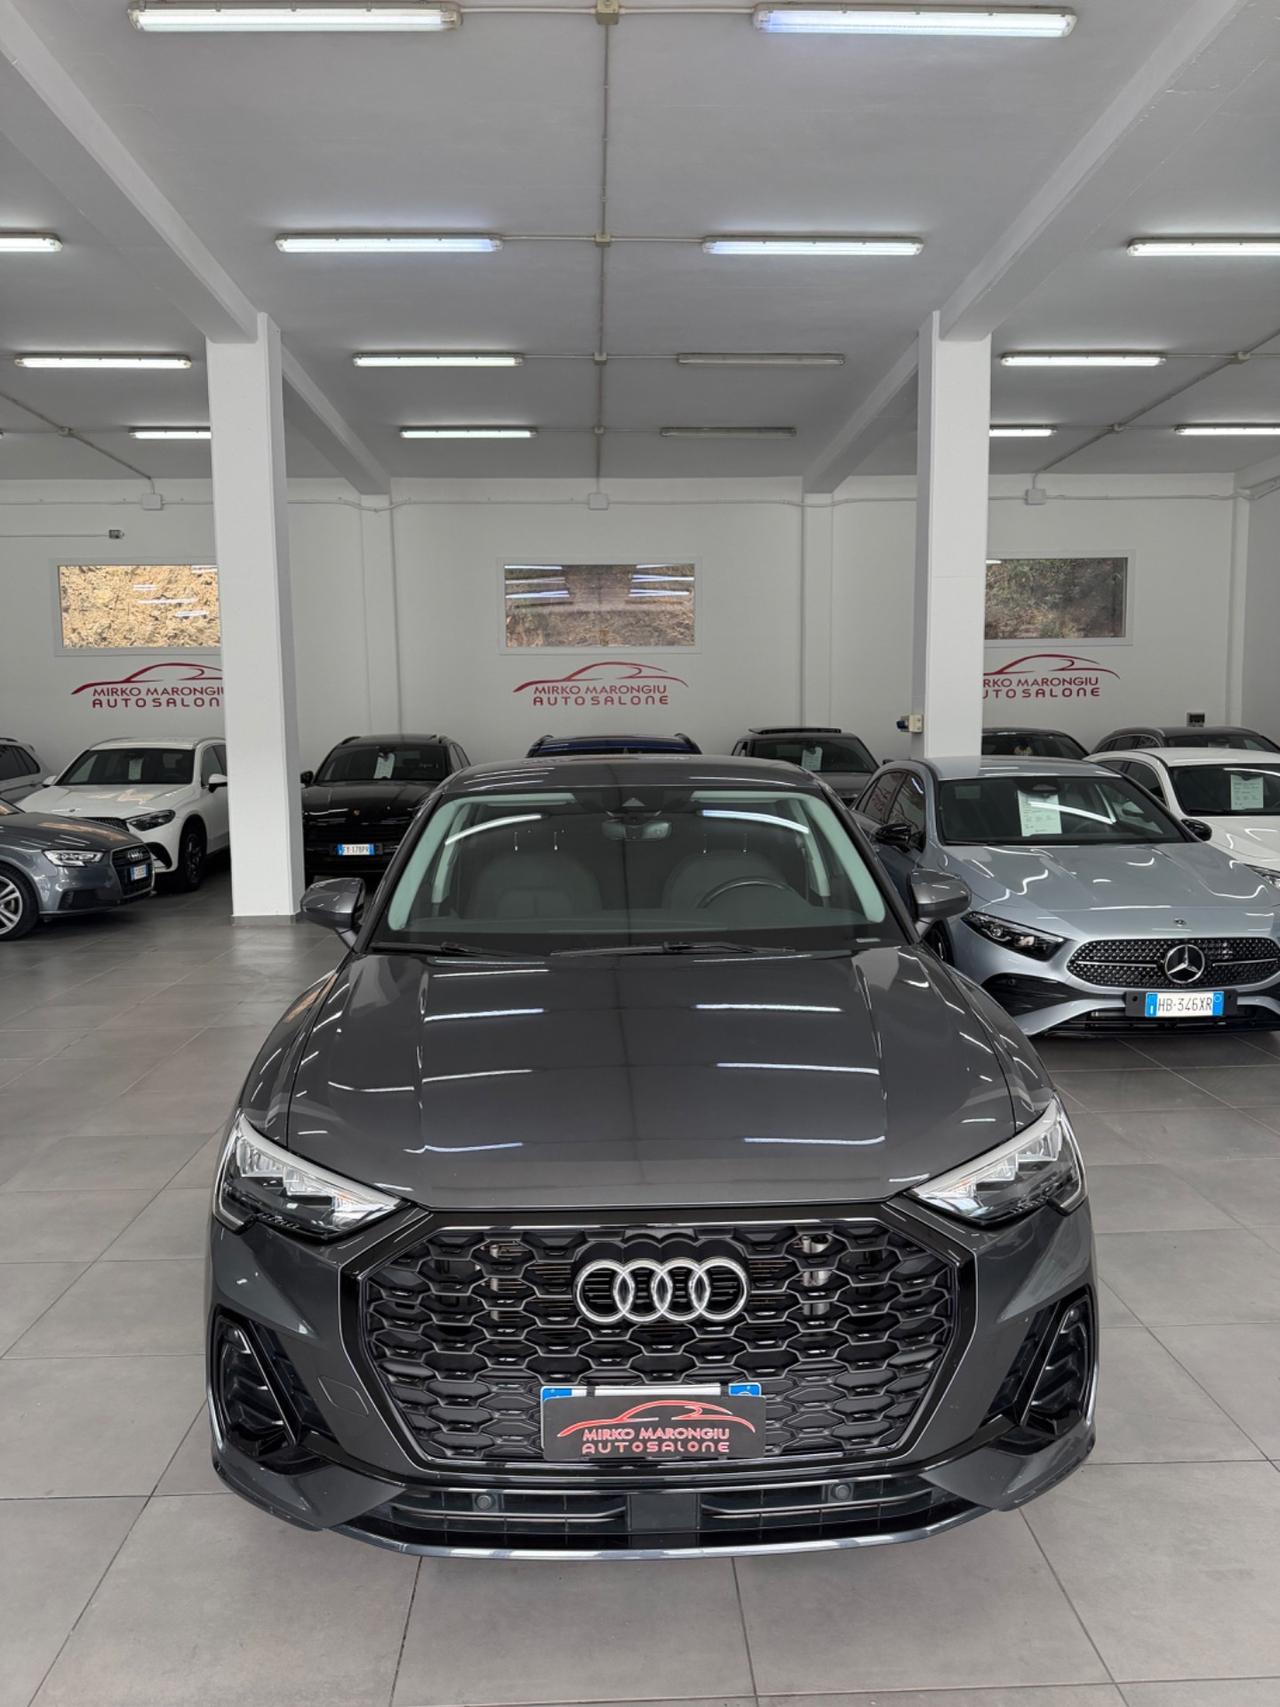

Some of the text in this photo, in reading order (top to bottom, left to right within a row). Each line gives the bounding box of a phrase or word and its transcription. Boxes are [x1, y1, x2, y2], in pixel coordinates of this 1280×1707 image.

[983, 676, 1099, 688] RKO MARONGIU
[92, 686, 224, 697] MIRKO MARONGI
[533, 684, 667, 695] MIRKO MARONGIU
[983, 687, 1100, 699] UTOSALONE
[92, 697, 220, 709] AUTOSALON
[533, 695, 669, 706] AUTOSALONE
[582, 1427, 730, 1441] MIRKO MARONGIU
[582, 1441, 730, 1454] AUTOSALONE
